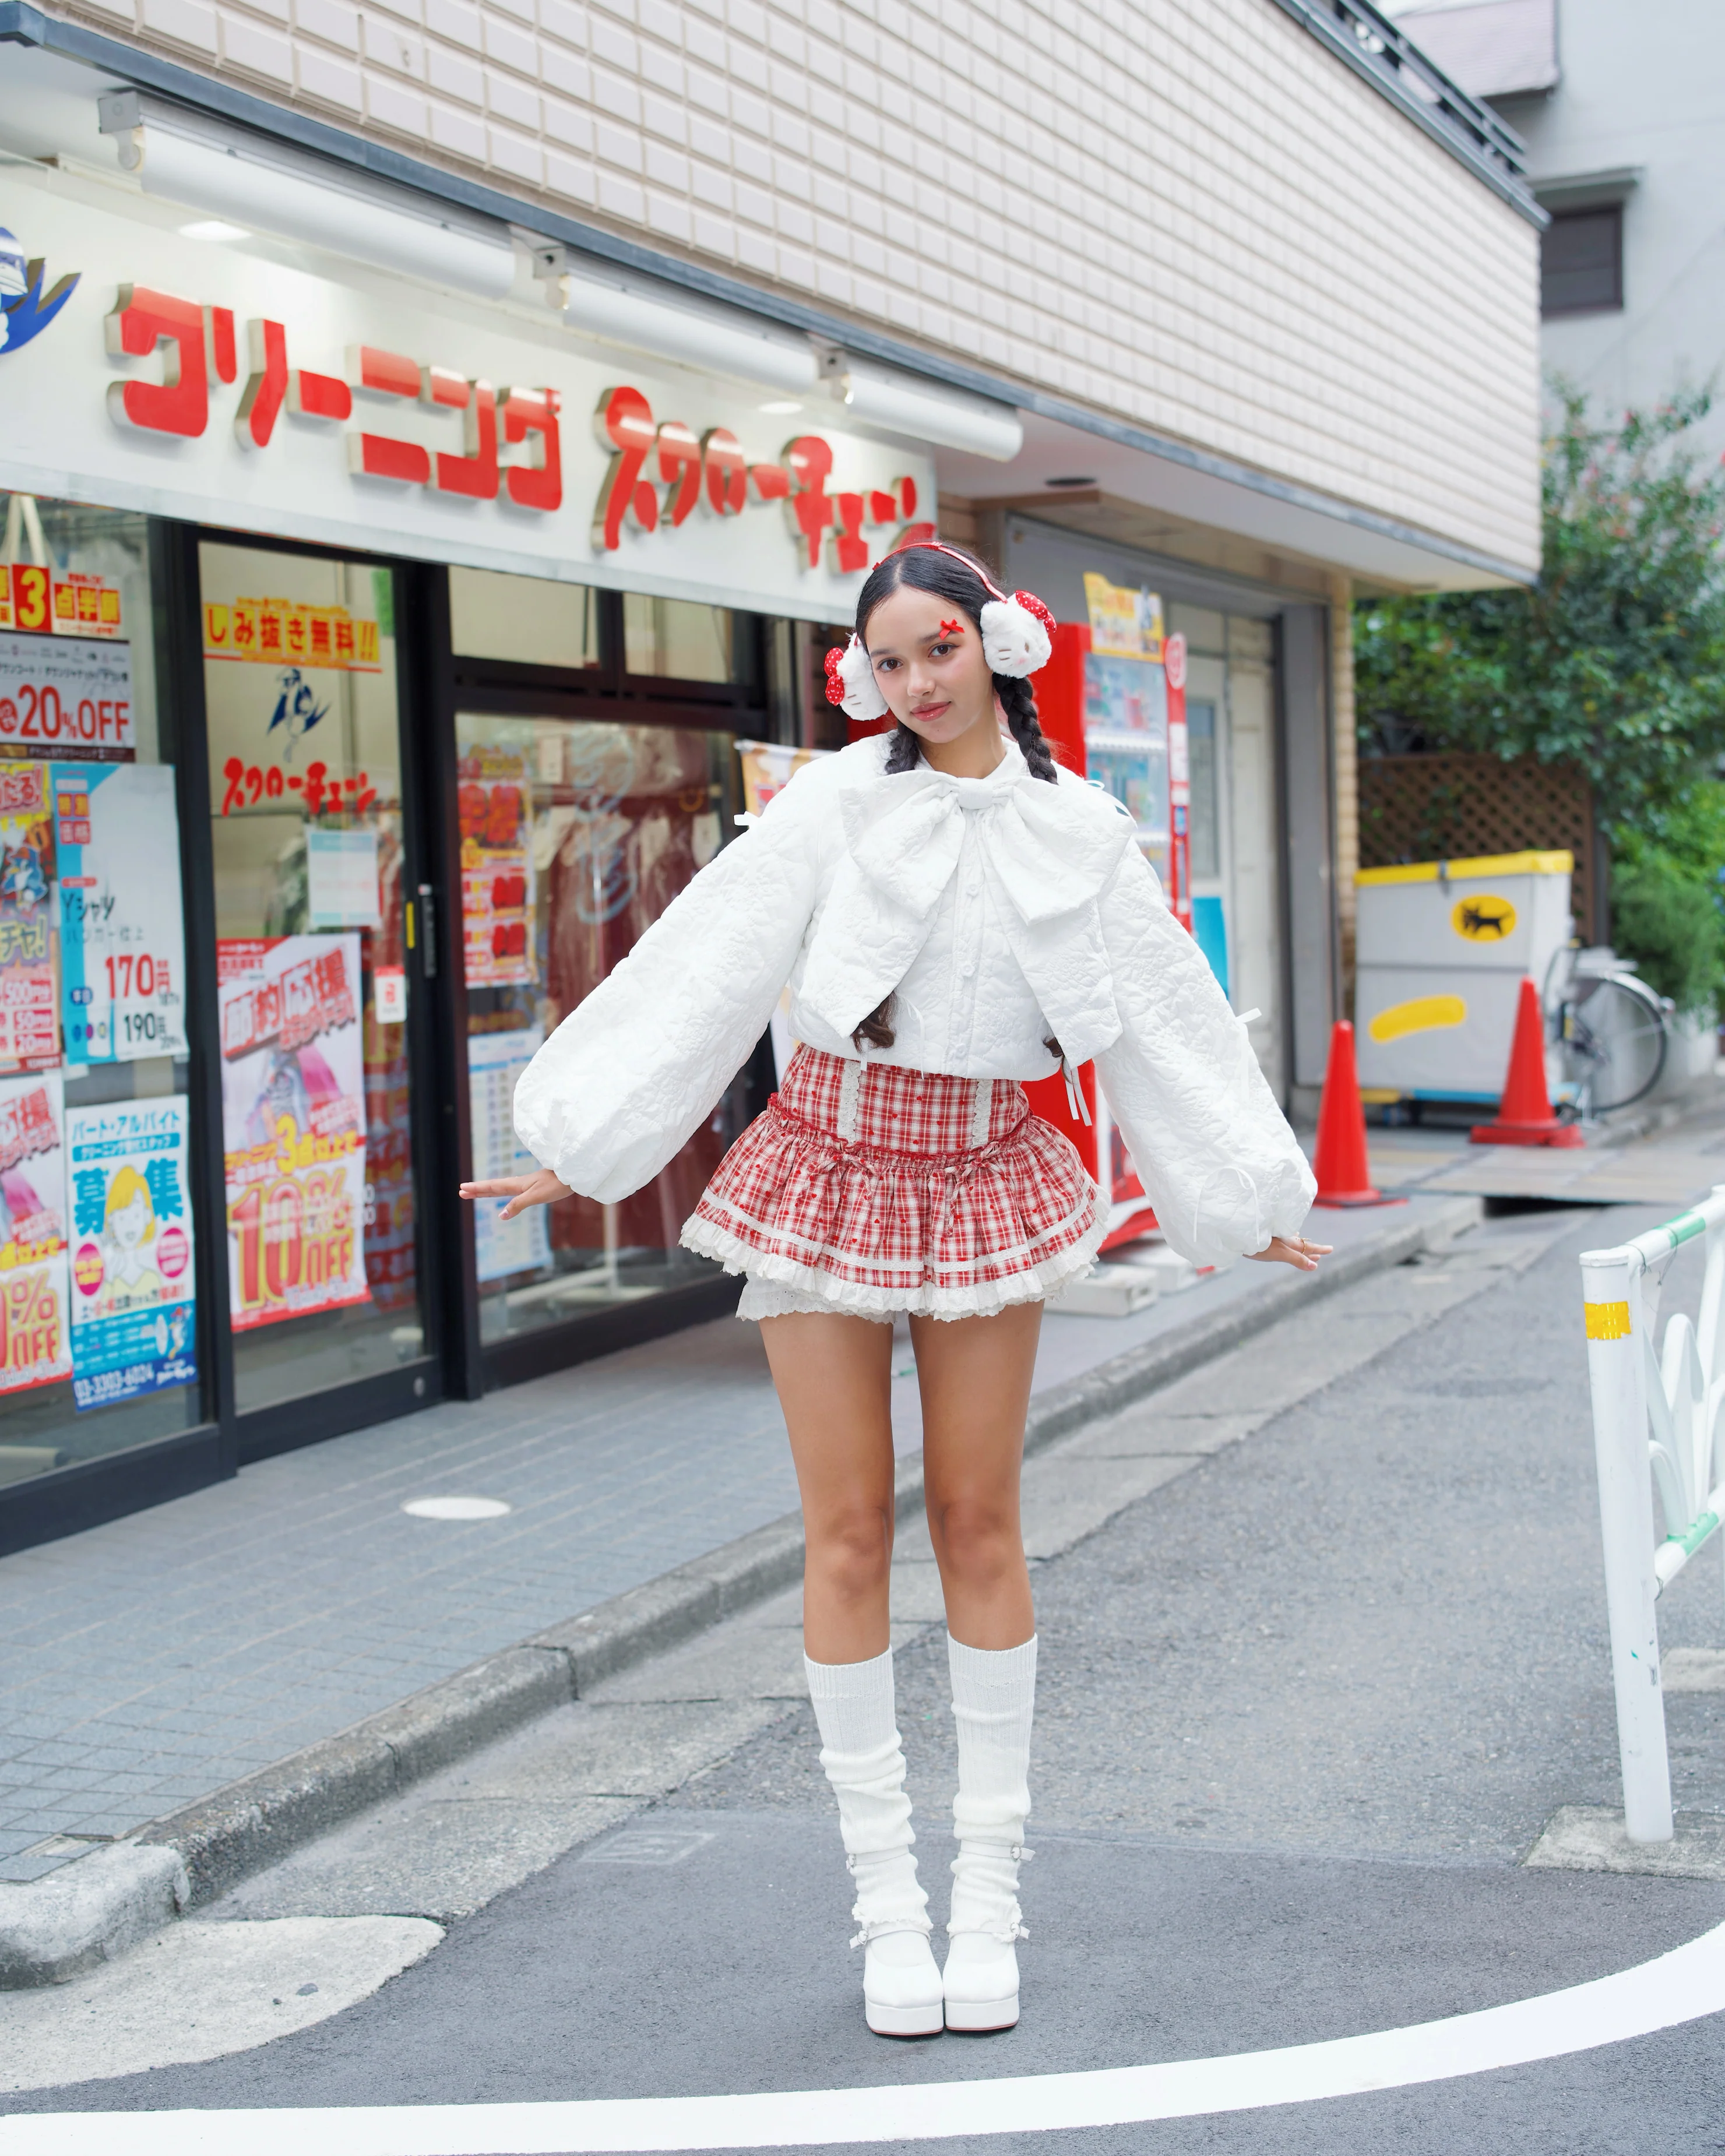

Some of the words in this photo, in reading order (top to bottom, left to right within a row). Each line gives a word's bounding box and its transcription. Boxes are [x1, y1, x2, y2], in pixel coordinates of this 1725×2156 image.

[106, 283, 562, 512] クリーニング
[18, 684, 129, 741] 20%OFF
[61, 892, 115, 922] Yシャツ
[72, 1109, 179, 1142] パート・アルバイト
[73, 1157, 184, 1236] 募集
